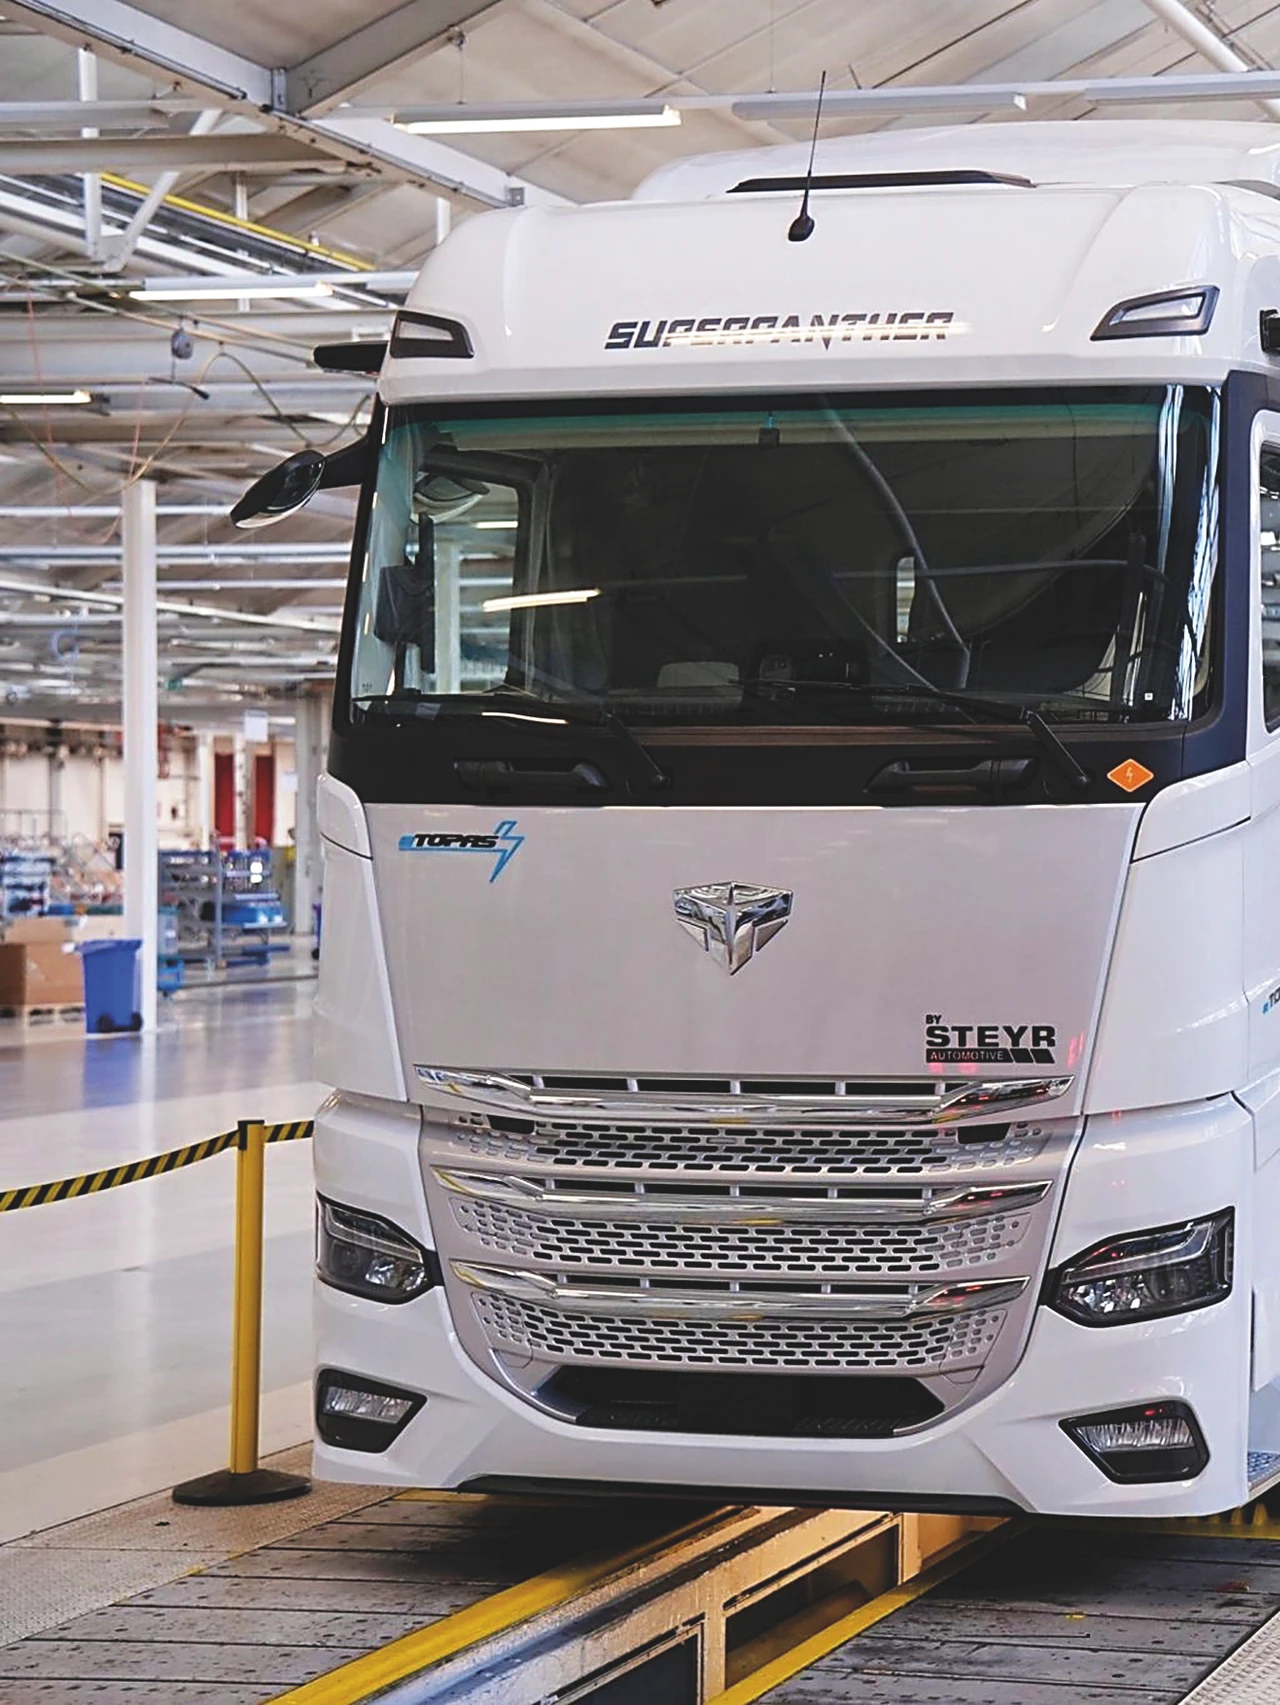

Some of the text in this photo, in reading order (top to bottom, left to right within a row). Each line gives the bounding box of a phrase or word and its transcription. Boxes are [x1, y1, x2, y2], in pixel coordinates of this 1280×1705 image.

[604, 311, 954, 350] SUPERPANTHER
[925, 1014, 942, 1024] BY
[925, 1025, 1056, 1047] STEYR
[930, 1050, 1005, 1061] AUTOMOTIVE
